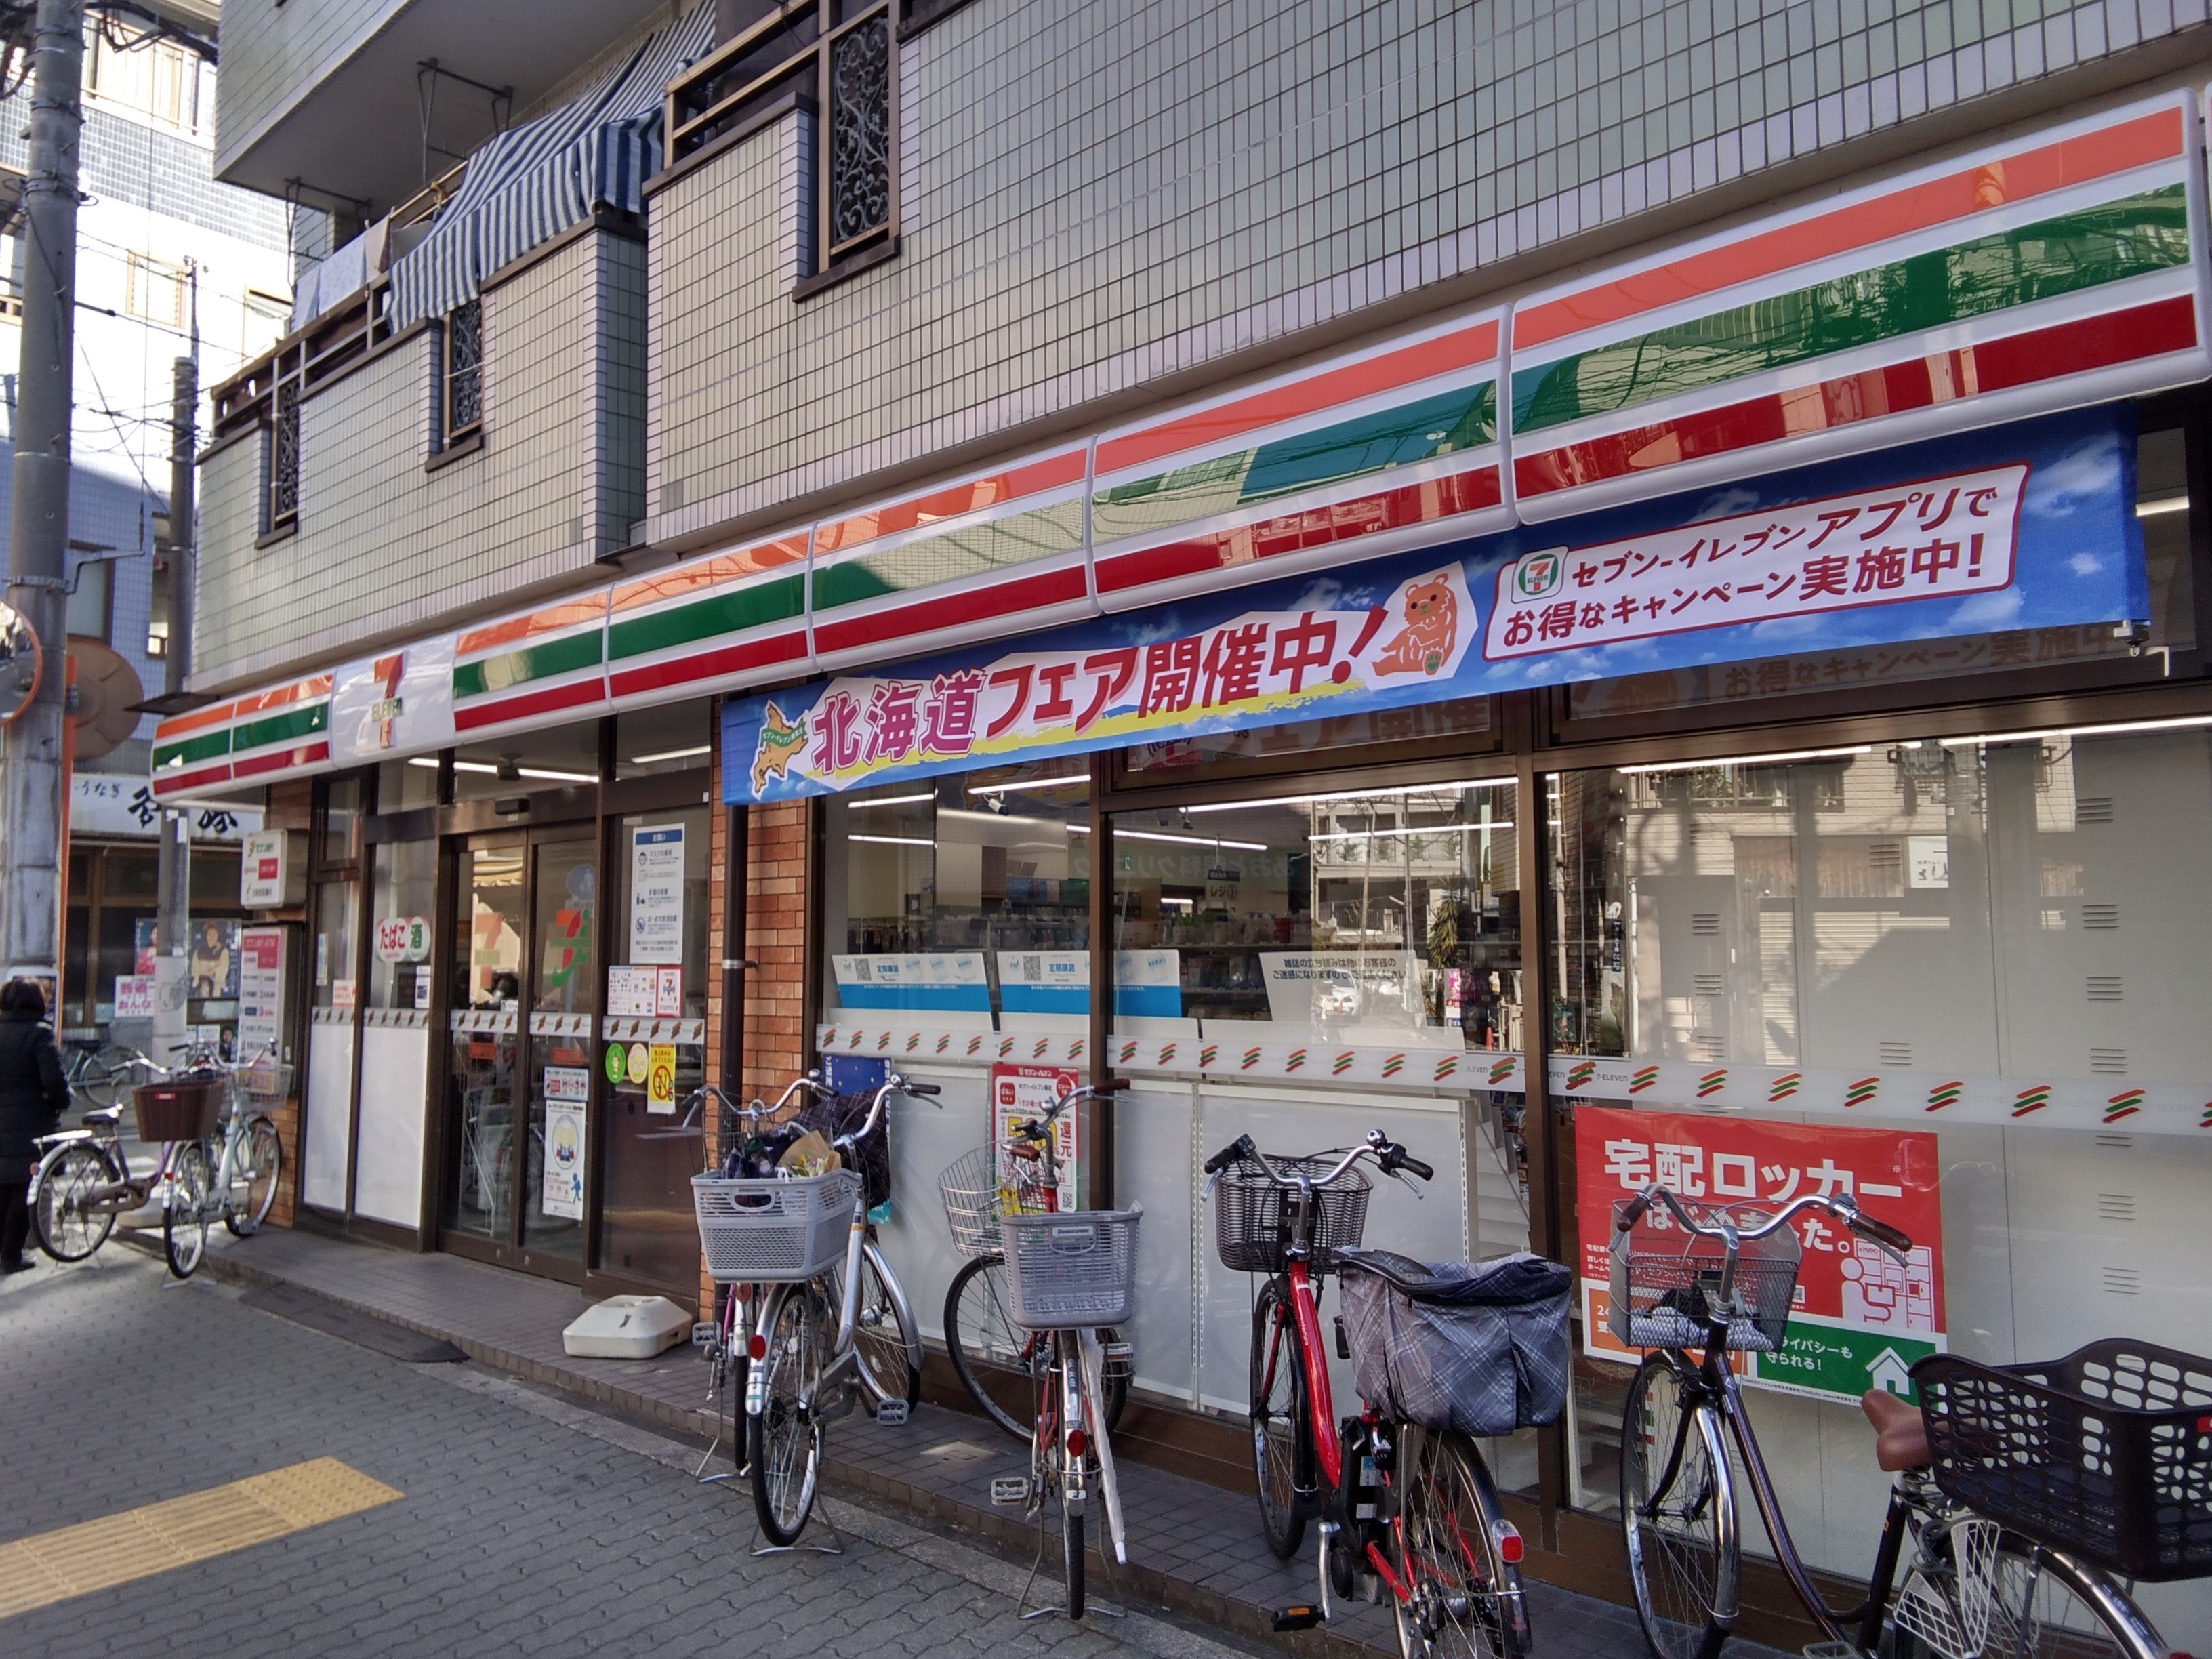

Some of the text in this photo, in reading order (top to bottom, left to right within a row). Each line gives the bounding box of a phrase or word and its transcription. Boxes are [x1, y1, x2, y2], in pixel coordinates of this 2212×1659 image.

[1572, 485, 2000, 588] セブン-イレブンアプリで
[1502, 532, 1984, 648] お得なキャンペーン実施中!
[379, 923, 423, 950] たばこ 酒
[1603, 1138, 1903, 1203] 宅配ロッカー
